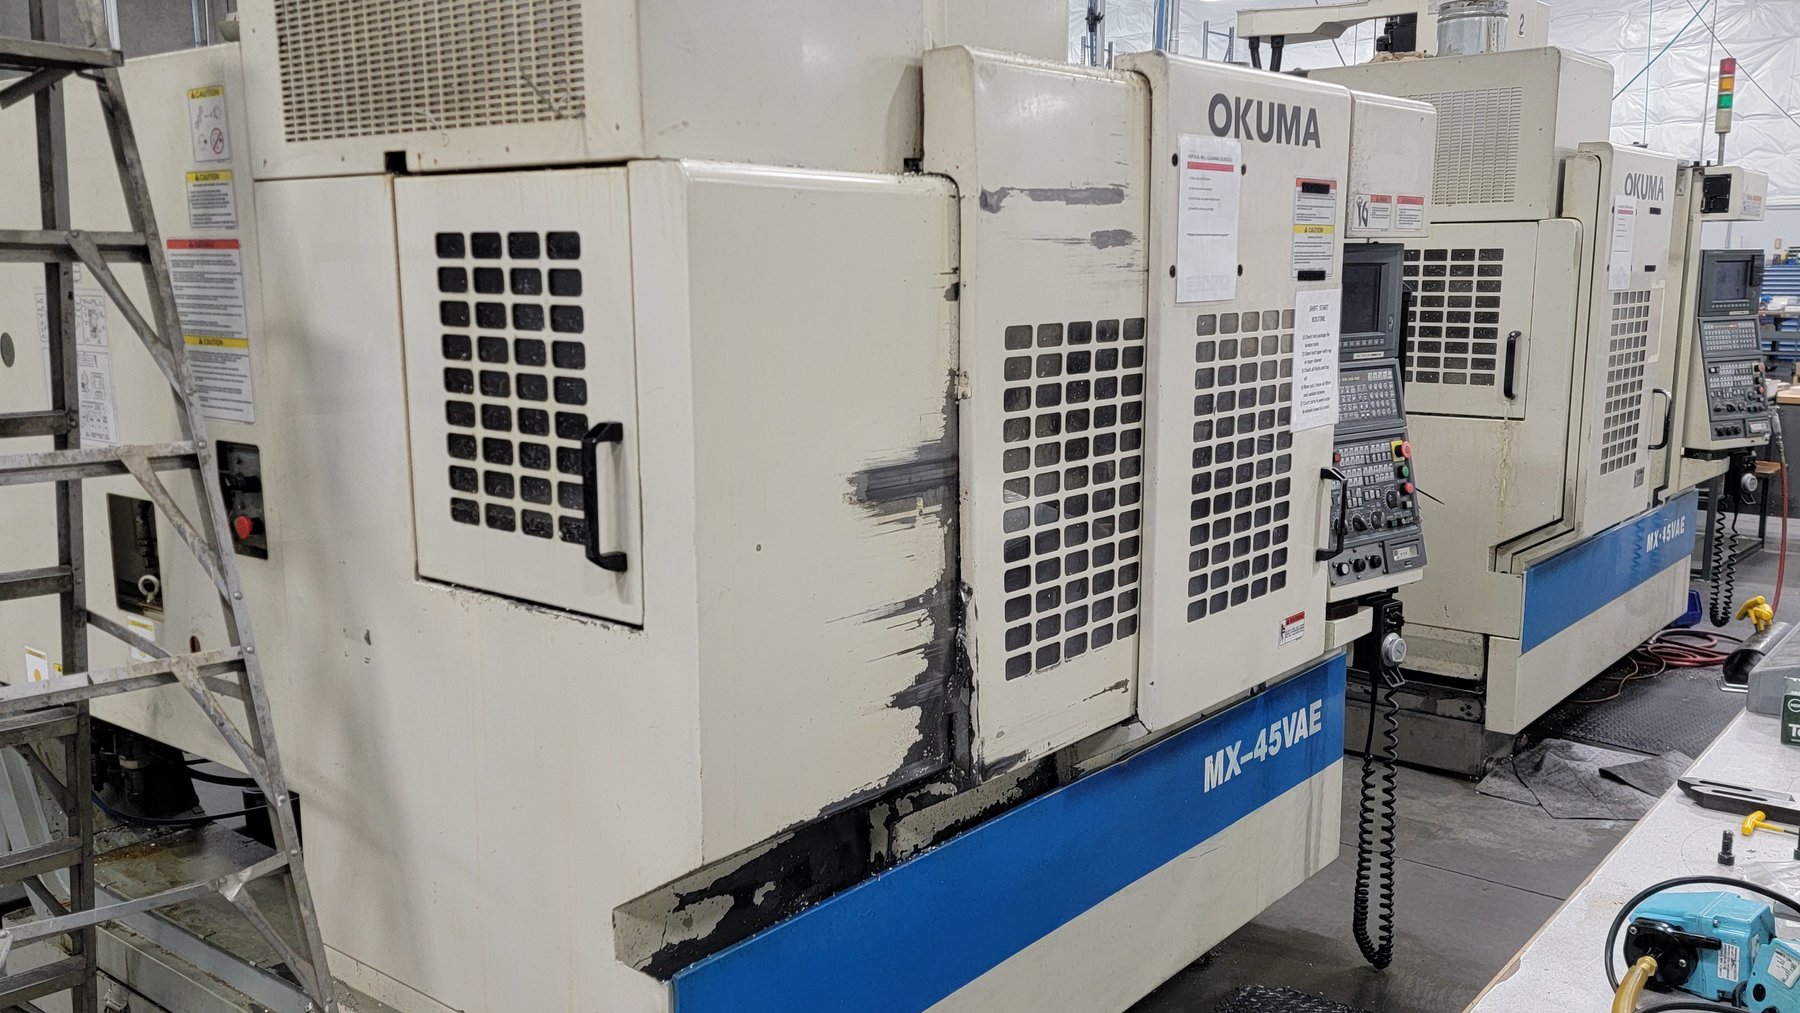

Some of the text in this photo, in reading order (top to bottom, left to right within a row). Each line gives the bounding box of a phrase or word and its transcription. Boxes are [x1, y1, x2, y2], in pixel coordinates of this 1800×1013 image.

[1518, 12, 1525, 36] 2
[194, 88, 220, 98] CAUTION
[1208, 92, 1321, 149] OKUMA
[199, 172, 220, 182] CAUTION
[1624, 172, 1664, 202] OKUMA
[1312, 315, 1326, 323] ROUTINE
[203, 338, 224, 346] CAUTION
[1646, 515, 1686, 554] MX-45VAE
[1203, 698, 1322, 794] MX-45VAE
